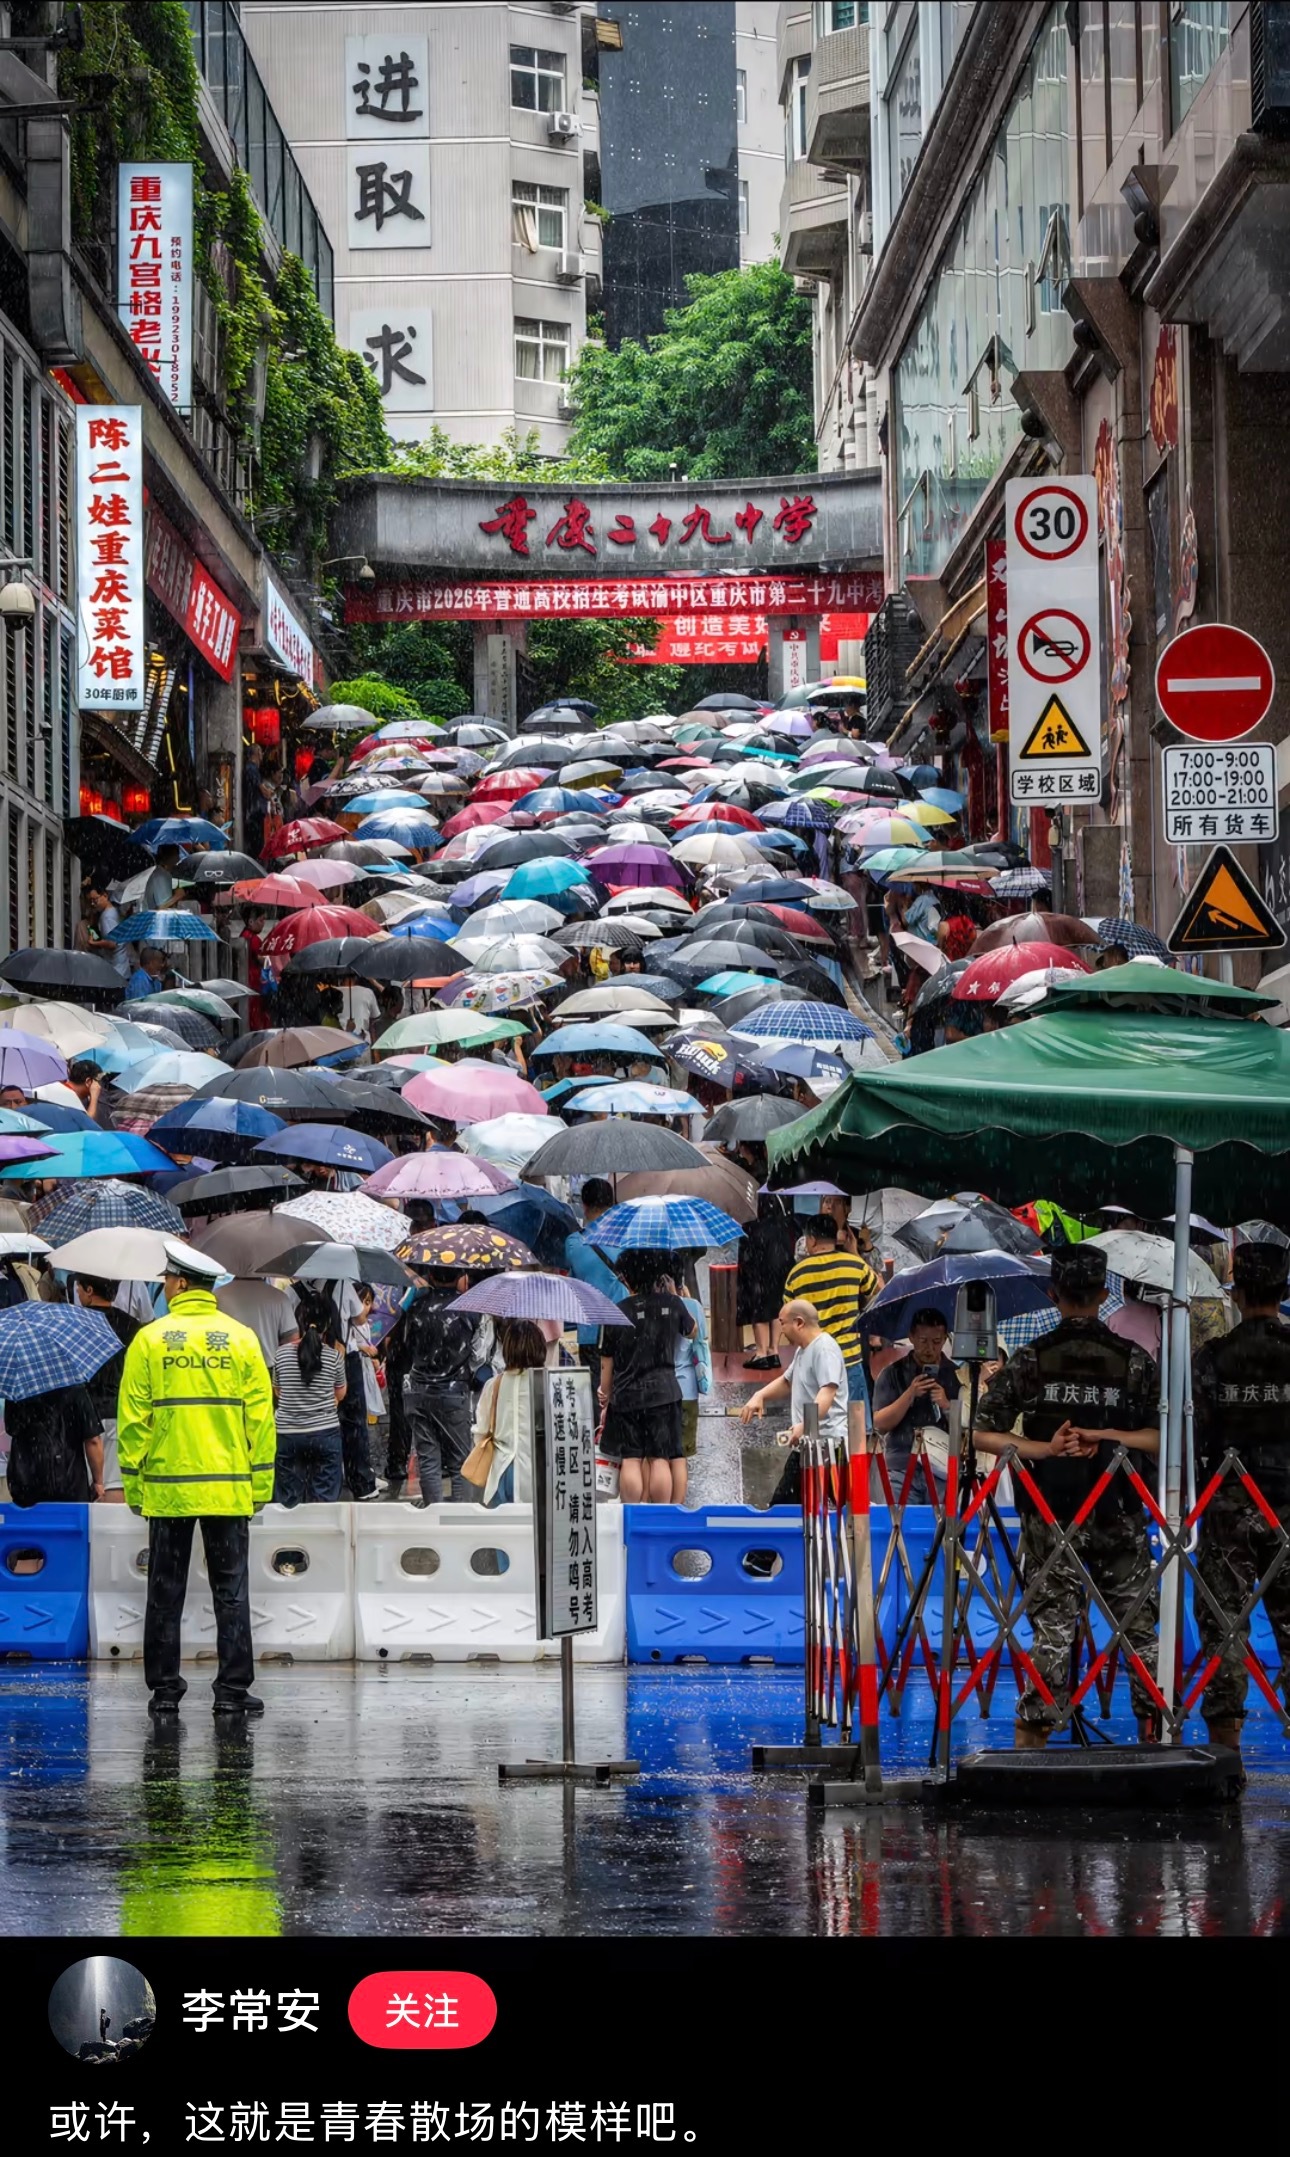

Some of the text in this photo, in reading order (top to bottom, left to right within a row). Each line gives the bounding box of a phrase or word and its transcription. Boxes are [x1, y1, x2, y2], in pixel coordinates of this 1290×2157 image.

[353, 51, 426, 451] 进取求
[129, 176, 162, 384] 重庆九宫格老
[479, 495, 818, 556] 重庆二十九中学
[1028, 506, 1076, 541] 30
[87, 417, 134, 680] 陈二娃重庆菜馆
[84, 688, 138, 702] 30年厨师
[1179, 750, 1260, 769] 7:00-9:00
[1016, 772, 1096, 796] 学校区域
[1173, 770, 1265, 788] 17:00-19:00
[1171, 787, 1268, 806] 20:00-21:00
[1172, 813, 1270, 837] 所有货车
[162, 1330, 229, 1351] 警察
[163, 1356, 231, 1370] POLICE
[1044, 1382, 1121, 1407] 重庆武警
